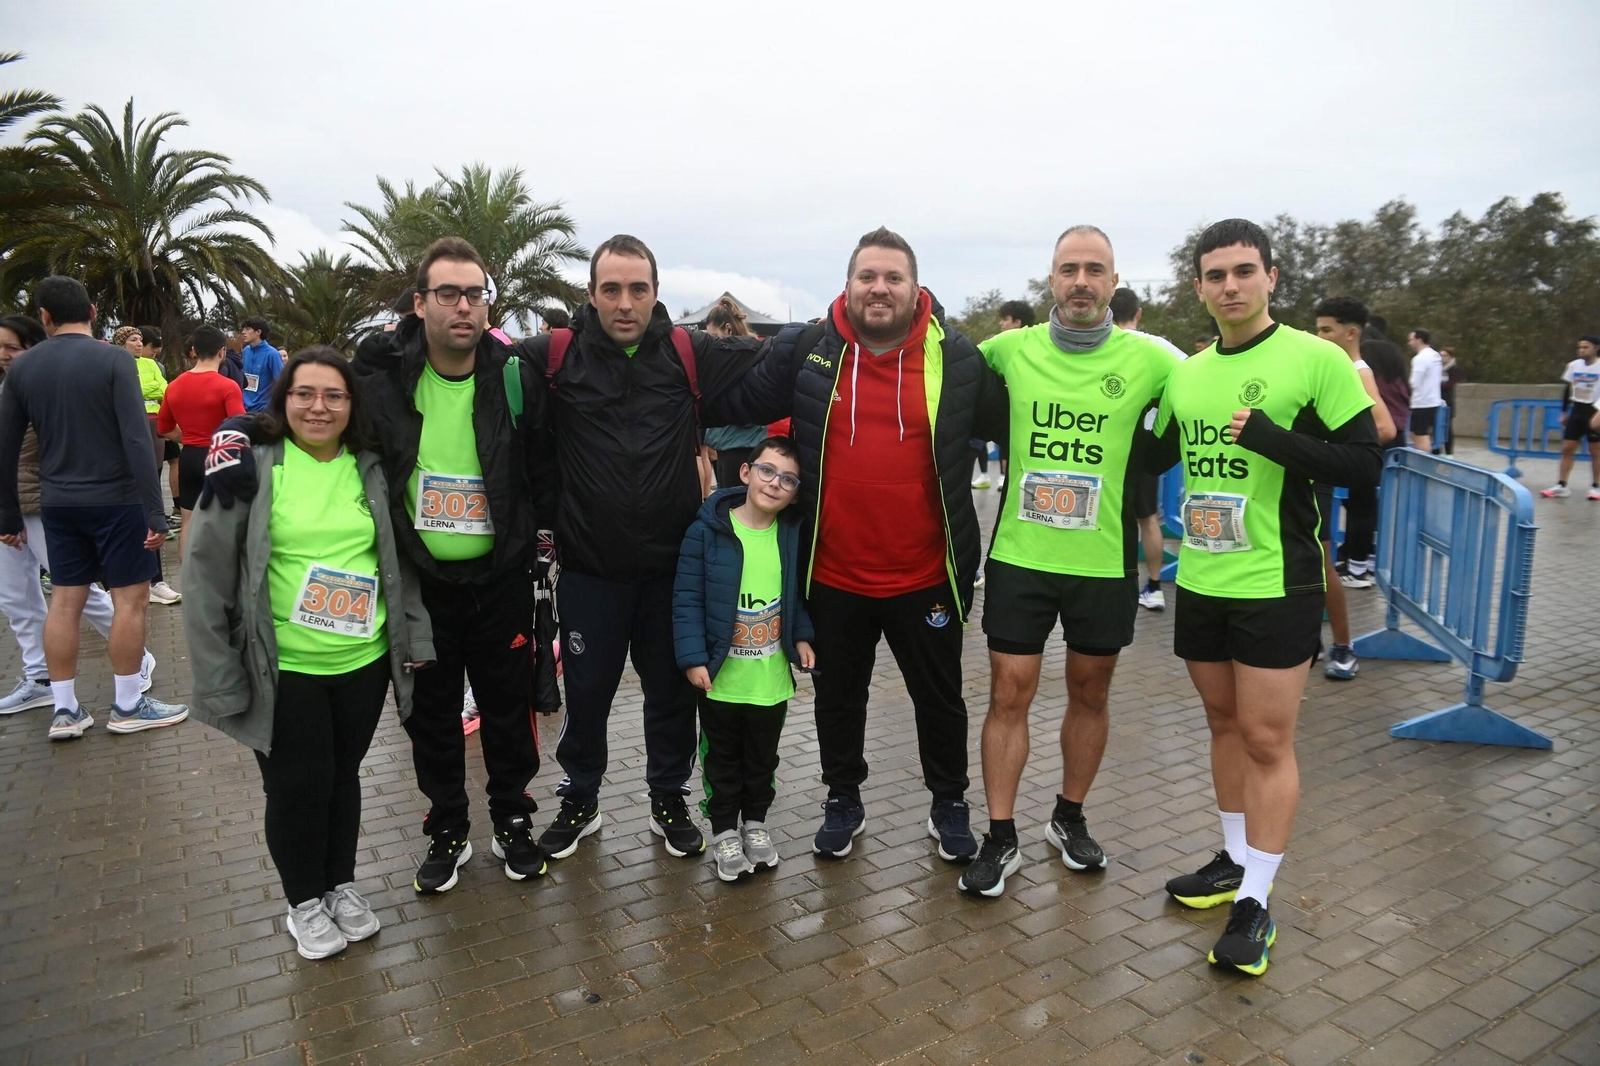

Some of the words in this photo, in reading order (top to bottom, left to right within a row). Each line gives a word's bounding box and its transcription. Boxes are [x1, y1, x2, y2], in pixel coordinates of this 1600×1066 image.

[1032, 401, 1109, 433] Uber
[1181, 419, 1232, 446] Ube
[1029, 432, 1104, 465] Eats
[1186, 451, 1249, 480] Eats
[422, 489, 488, 520] 302
[1033, 485, 1077, 515] 50
[1190, 508, 1222, 538] 55
[302, 582, 369, 621] 304
[731, 616, 781, 646] 298
